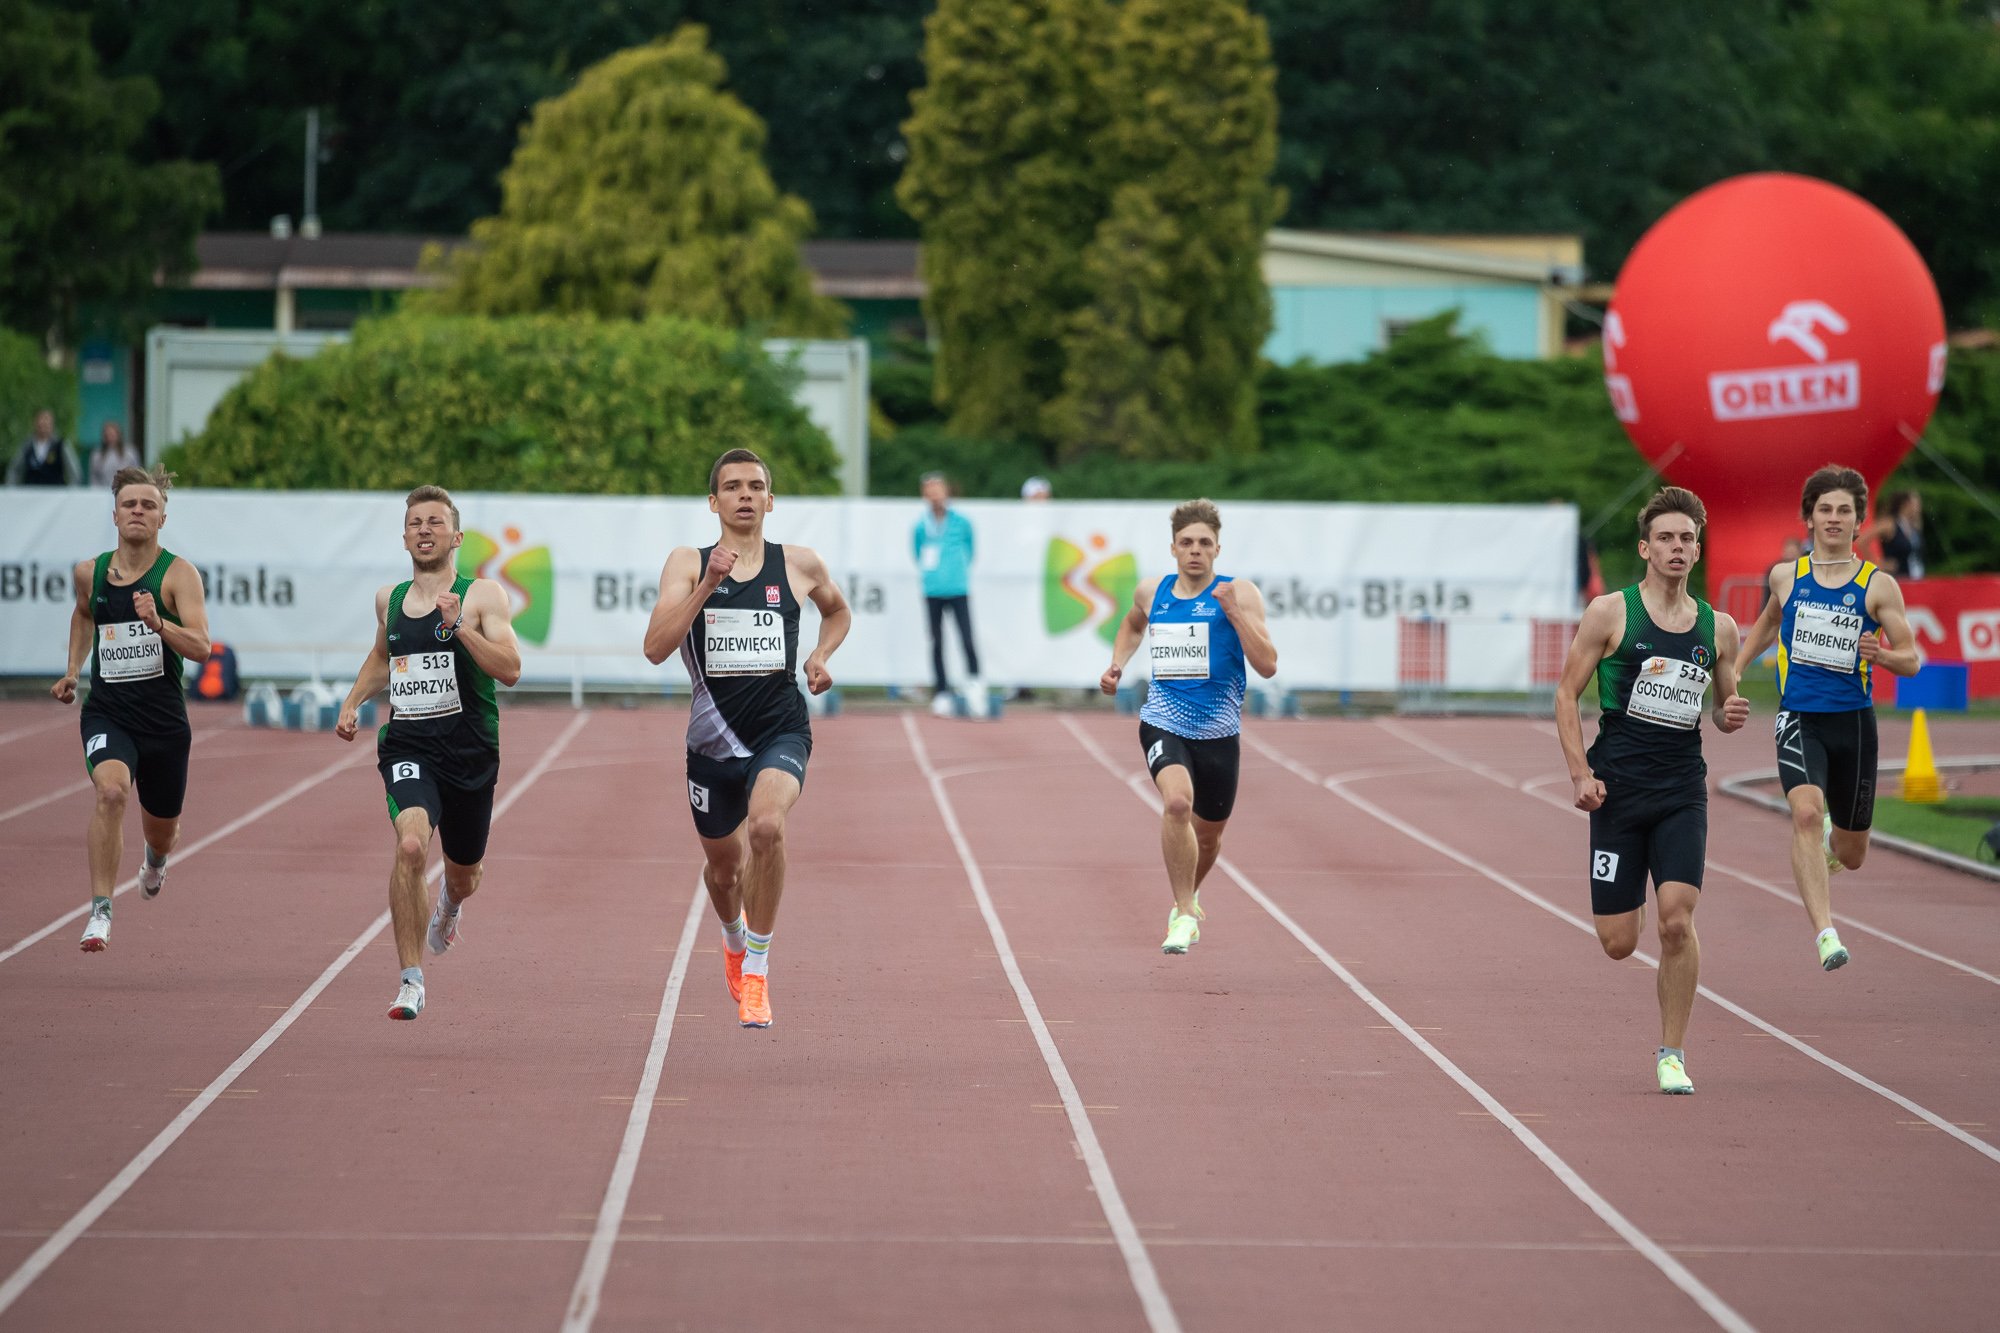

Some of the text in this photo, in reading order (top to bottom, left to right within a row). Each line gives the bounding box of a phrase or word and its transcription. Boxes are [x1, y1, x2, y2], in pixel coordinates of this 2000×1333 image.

[1722, 374, 1846, 409] ORLEN
[1793, 600, 1856, 615] STALOWA WOLA
[752, 612, 773, 627] 10
[1831, 615, 1859, 630] 444
[1188, 625, 1195, 637] 1
[707, 637, 782, 654] DZIEWIĘCKI
[1795, 629, 1857, 652] BEMBENEK
[100, 643, 160, 662] KOŁODZIEJSKI
[422, 655, 450, 670] 513
[1680, 664, 1706, 684] 511
[392, 678, 455, 697] KASPRZYK
[1637, 680, 1700, 707] GOSTOMCZYK
[90, 735, 101, 750] 7
[1150, 744, 1157, 760] 4
[399, 763, 413, 778] 6
[692, 786, 703, 807] 5
[1596, 854, 1611, 878] 3
